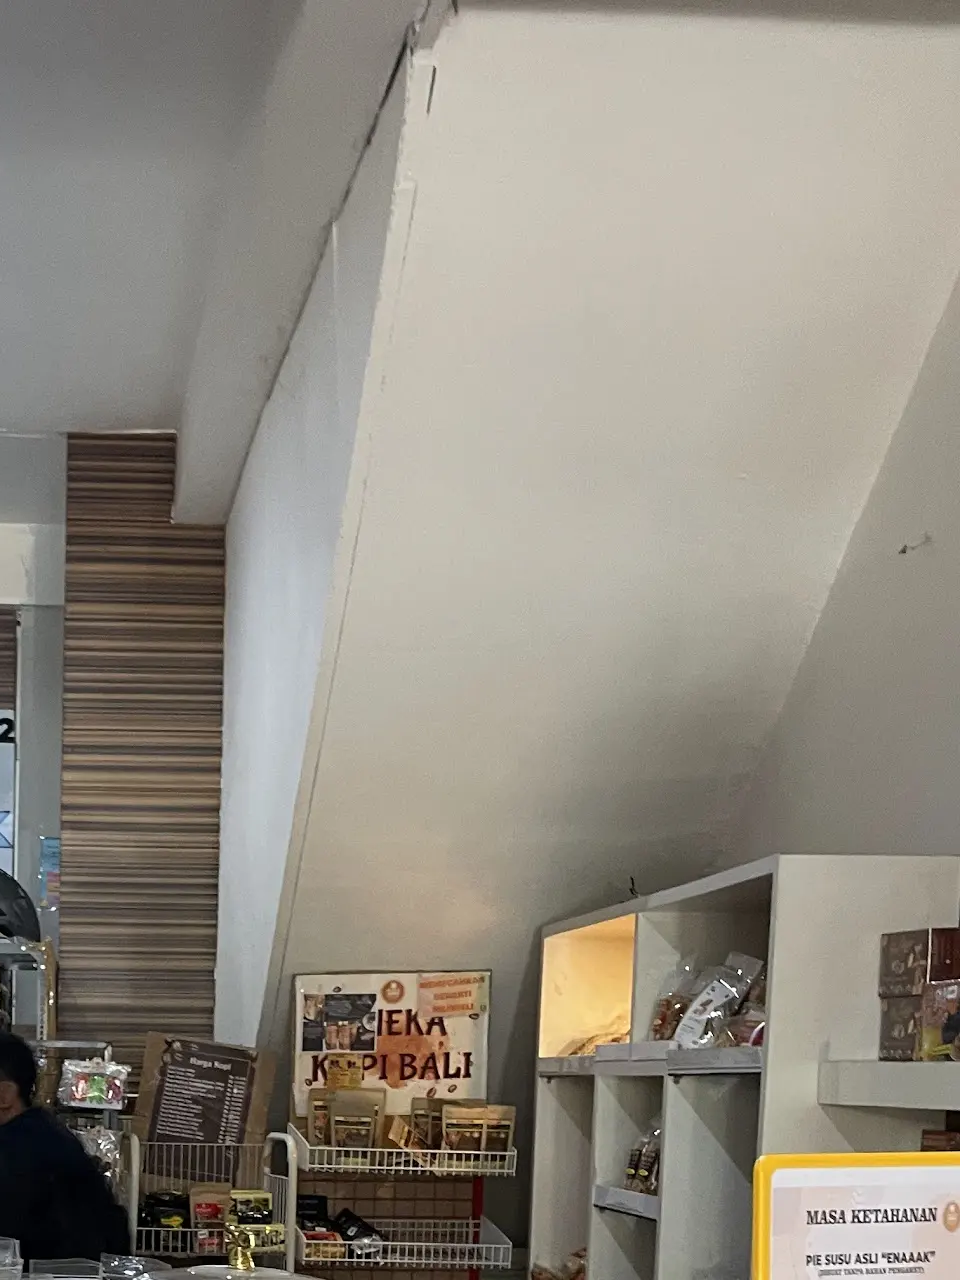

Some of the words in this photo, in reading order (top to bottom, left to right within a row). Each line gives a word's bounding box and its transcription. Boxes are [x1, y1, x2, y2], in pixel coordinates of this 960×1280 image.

[311, 1053, 388, 1082] KPI
[398, 1051, 473, 1081] BALI
[806, 1208, 846, 1226] MASA
[850, 1206, 938, 1225] KETAHANAN
[806, 1253, 823, 1267] PIE
[824, 1253, 852, 1266] SUSU
[854, 1252, 880, 1266] ASLI
